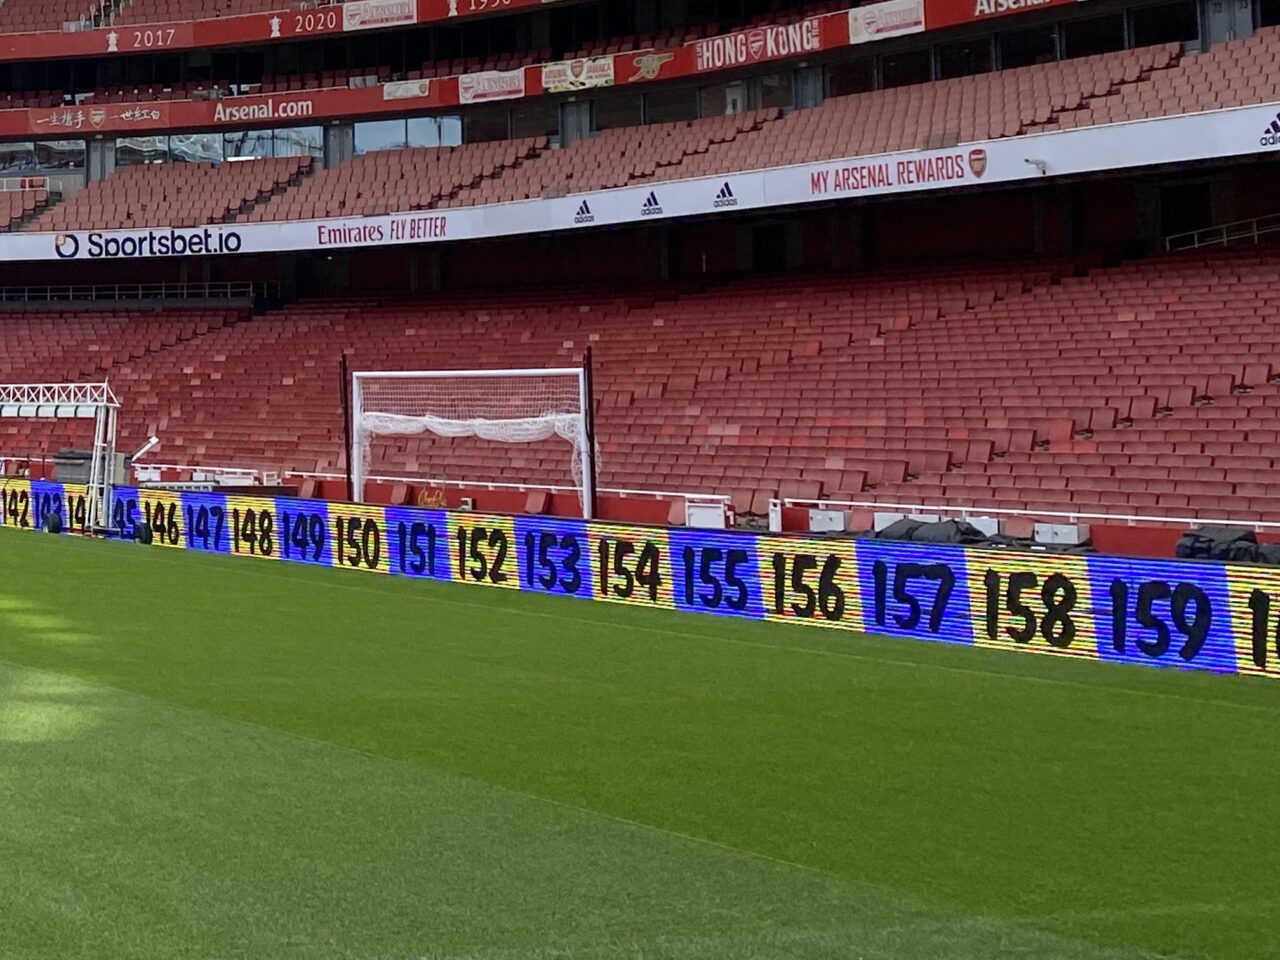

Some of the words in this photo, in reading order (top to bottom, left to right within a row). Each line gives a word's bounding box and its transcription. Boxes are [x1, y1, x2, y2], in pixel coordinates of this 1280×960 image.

[133, 29, 176, 49] 2017
[294, 11, 337, 33] 2020
[702, 33, 747, 70] HONG
[766, 20, 813, 58] KONG
[213, 98, 313, 122] Arsenal.com
[810, 170, 829, 194] MY
[833, 163, 894, 193] ARSENAL
[896, 155, 965, 185] REWARDS
[574, 213, 595, 224] adidas
[640, 206, 663, 217] adidas
[713, 196, 738, 208] adidas
[87, 227, 242, 258] Sportsbet.io
[317, 223, 385, 246] Emirates
[389, 219, 407, 240] FLY
[409, 215, 447, 239] BETTER
[0, 488, 29, 528] 142
[187, 503, 224, 551] 147
[232, 507, 274, 557] 148
[281, 510, 325, 562] 149
[336, 515, 381, 570] 150
[397, 521, 436, 577] 151
[457, 525, 508, 583] 152
[524, 530, 582, 595] 153
[598, 537, 662, 603] 154
[682, 545, 749, 611] 155
[771, 551, 846, 622] 156
[871, 559, 956, 634] 157
[983, 566, 1078, 648] 158
[1108, 576, 1213, 663] 159
[1249, 586, 1280, 671] 1
